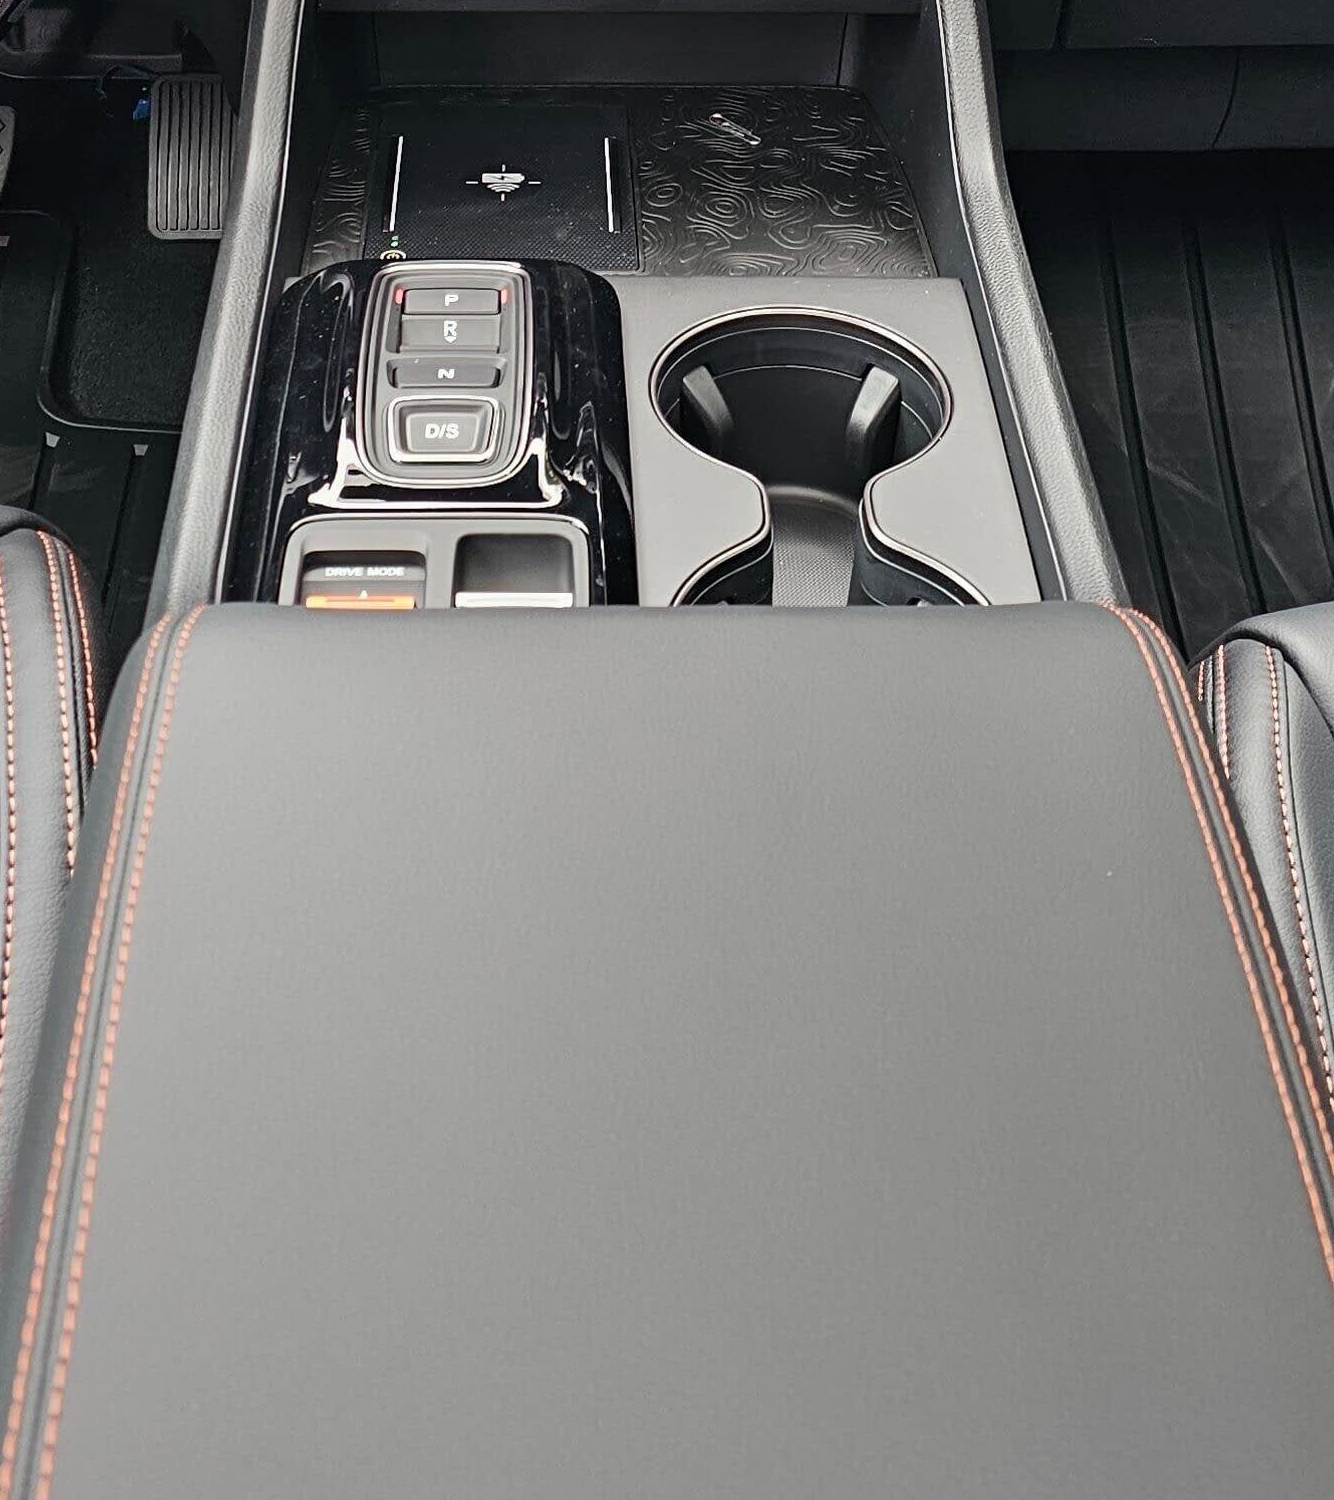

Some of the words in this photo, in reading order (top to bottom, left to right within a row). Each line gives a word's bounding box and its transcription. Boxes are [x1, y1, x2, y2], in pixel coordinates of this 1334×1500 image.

[444, 294, 459, 307] P
[443, 320, 458, 337] R
[437, 368, 456, 379] N
[424, 423, 460, 439] D/S
[325, 566, 365, 577] DRIVE
[367, 566, 406, 577] MODE
